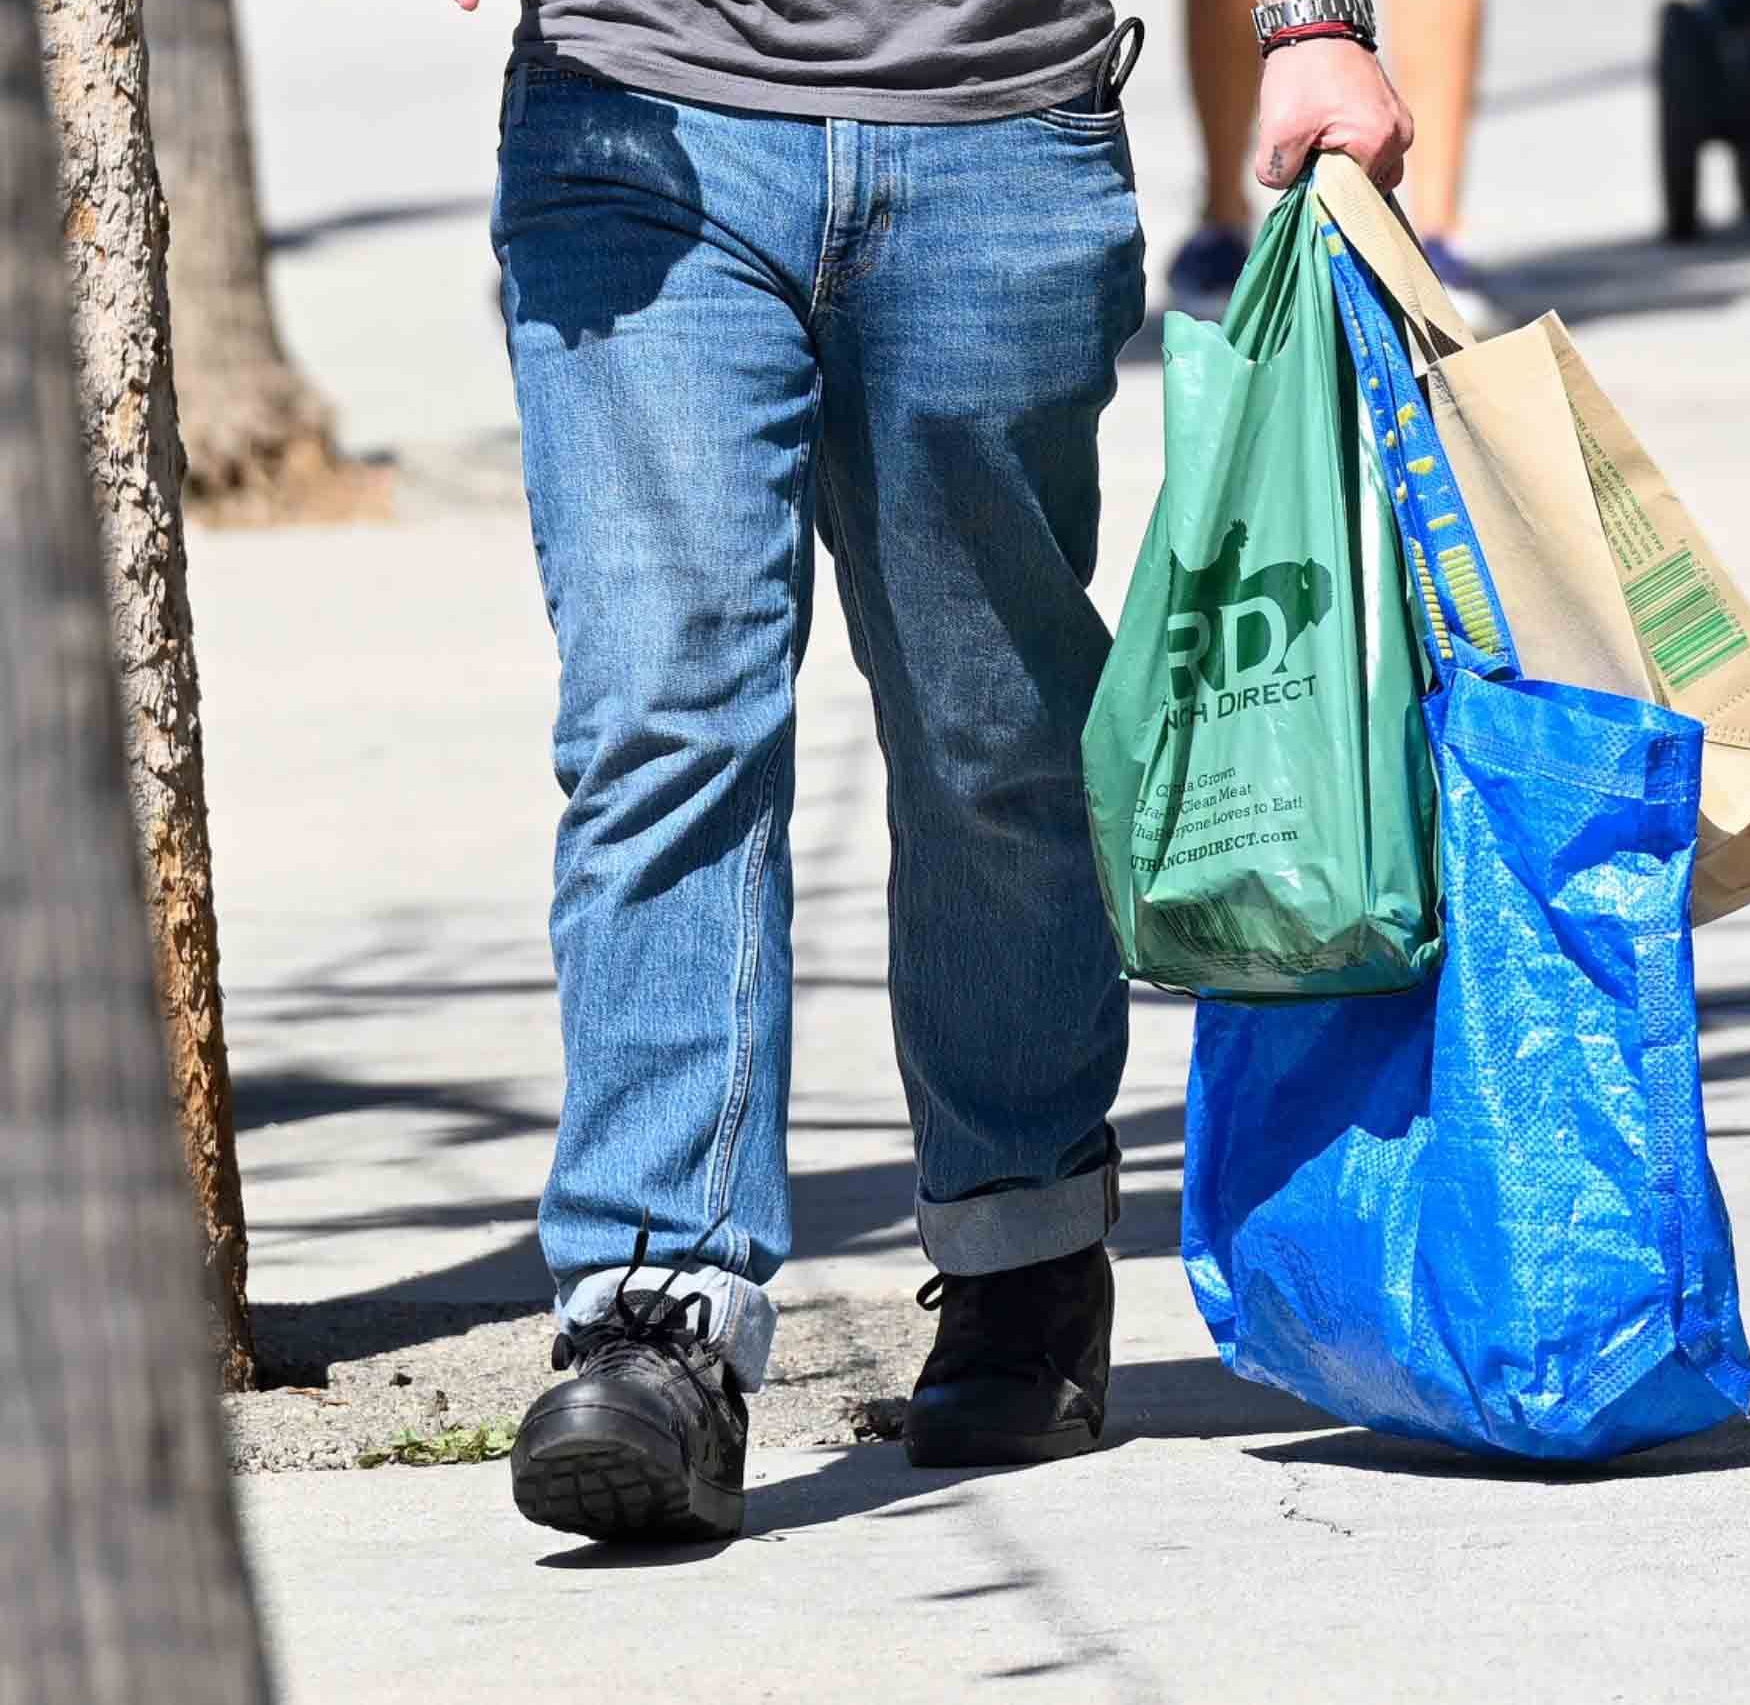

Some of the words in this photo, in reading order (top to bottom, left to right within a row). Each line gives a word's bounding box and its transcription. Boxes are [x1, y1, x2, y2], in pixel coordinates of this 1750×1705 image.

[1217, 674, 1317, 719] DIRECT
[1196, 766, 1237, 789] Grown
[1181, 793, 1218, 817] Clean
[1218, 783, 1252, 803] Meat
[1212, 805, 1251, 826] Loves
[1254, 800, 1268, 816] to
[1272, 795, 1304, 813] Eat!
